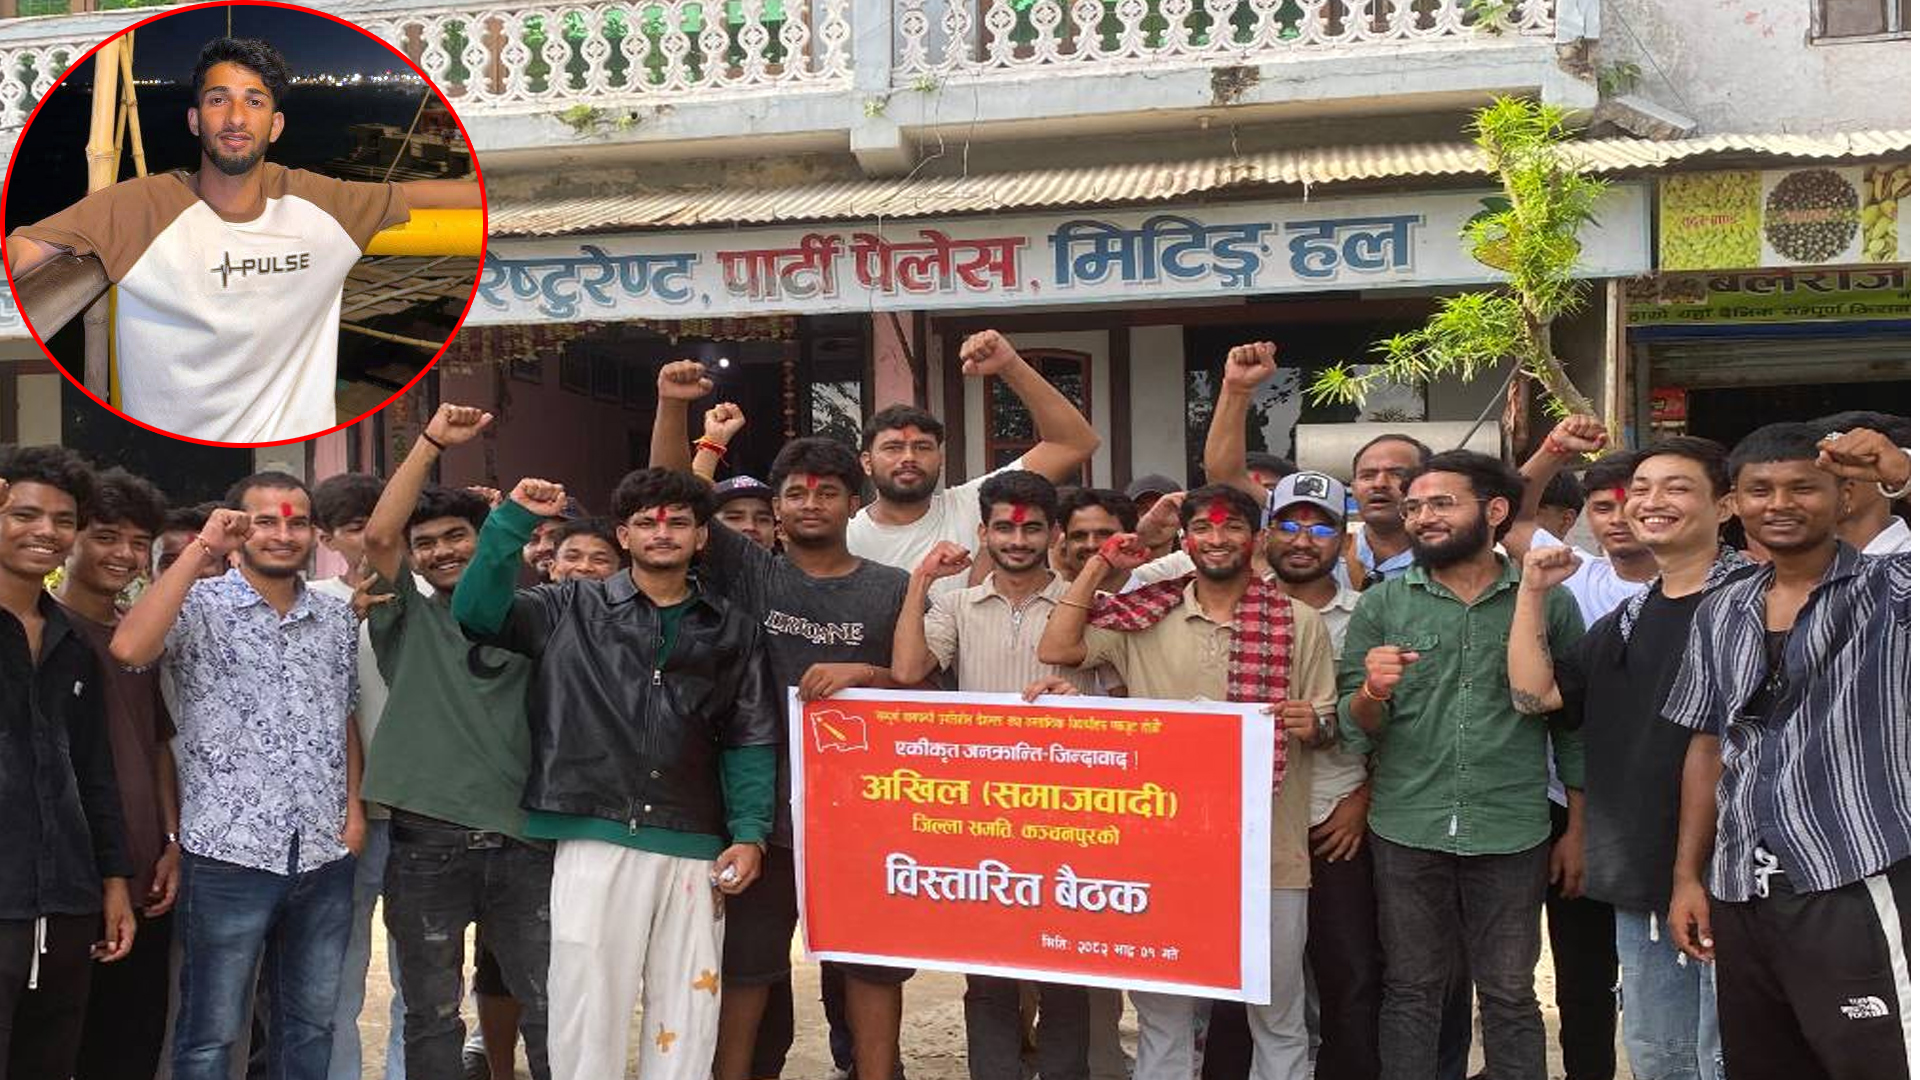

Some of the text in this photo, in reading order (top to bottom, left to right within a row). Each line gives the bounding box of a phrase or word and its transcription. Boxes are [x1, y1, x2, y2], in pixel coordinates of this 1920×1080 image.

[243, 252, 310, 277] PULSE
[717, 233, 843, 300] पार्टी
[1284, 214, 1421, 277] हल
[894, 738, 960, 763] एकीकृत
[862, 769, 1178, 819] अखिल (समाजवादी)
[912, 812, 963, 835] जिल्ला
[1022, 824, 1120, 848] कञ्चनपुरको
[885, 852, 1151, 914] विस्तारित बैठक
[1077, 940, 1109, 957] २०८२
